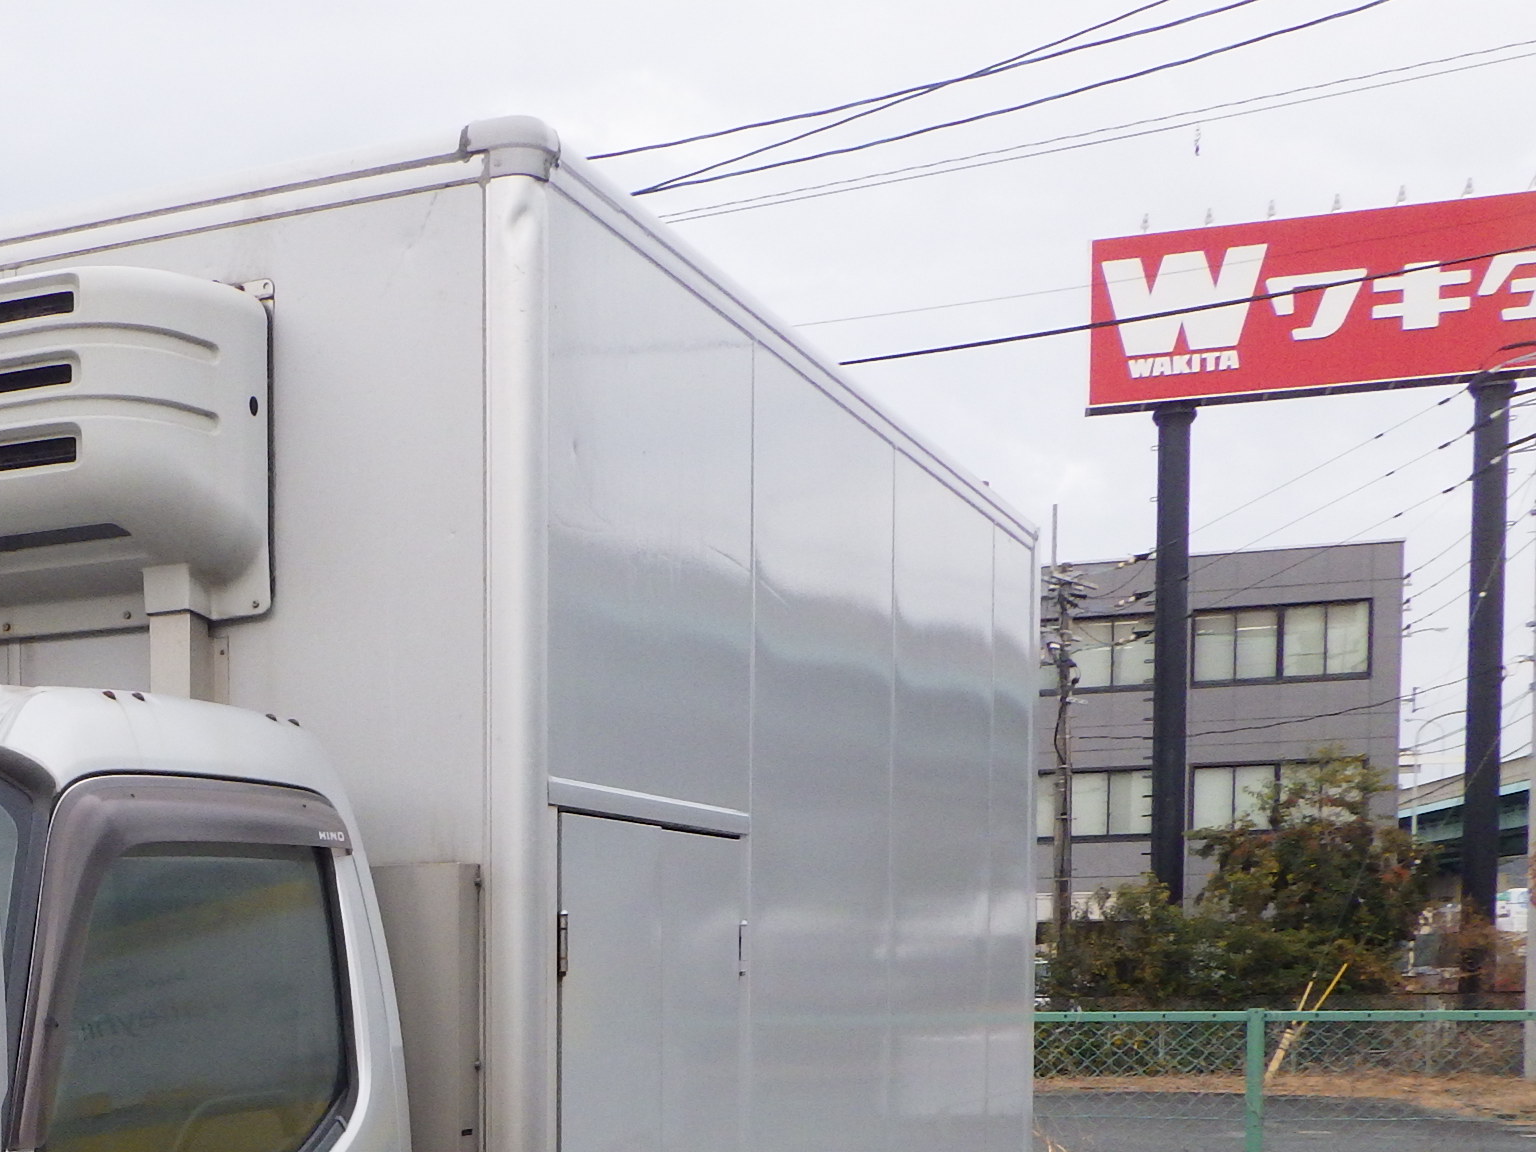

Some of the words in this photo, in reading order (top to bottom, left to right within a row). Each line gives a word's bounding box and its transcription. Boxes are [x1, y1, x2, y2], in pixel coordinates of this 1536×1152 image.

[1100, 243, 1268, 356] W
[1128, 349, 1240, 379] WAKITA
[318, 831, 345, 842] HINO
